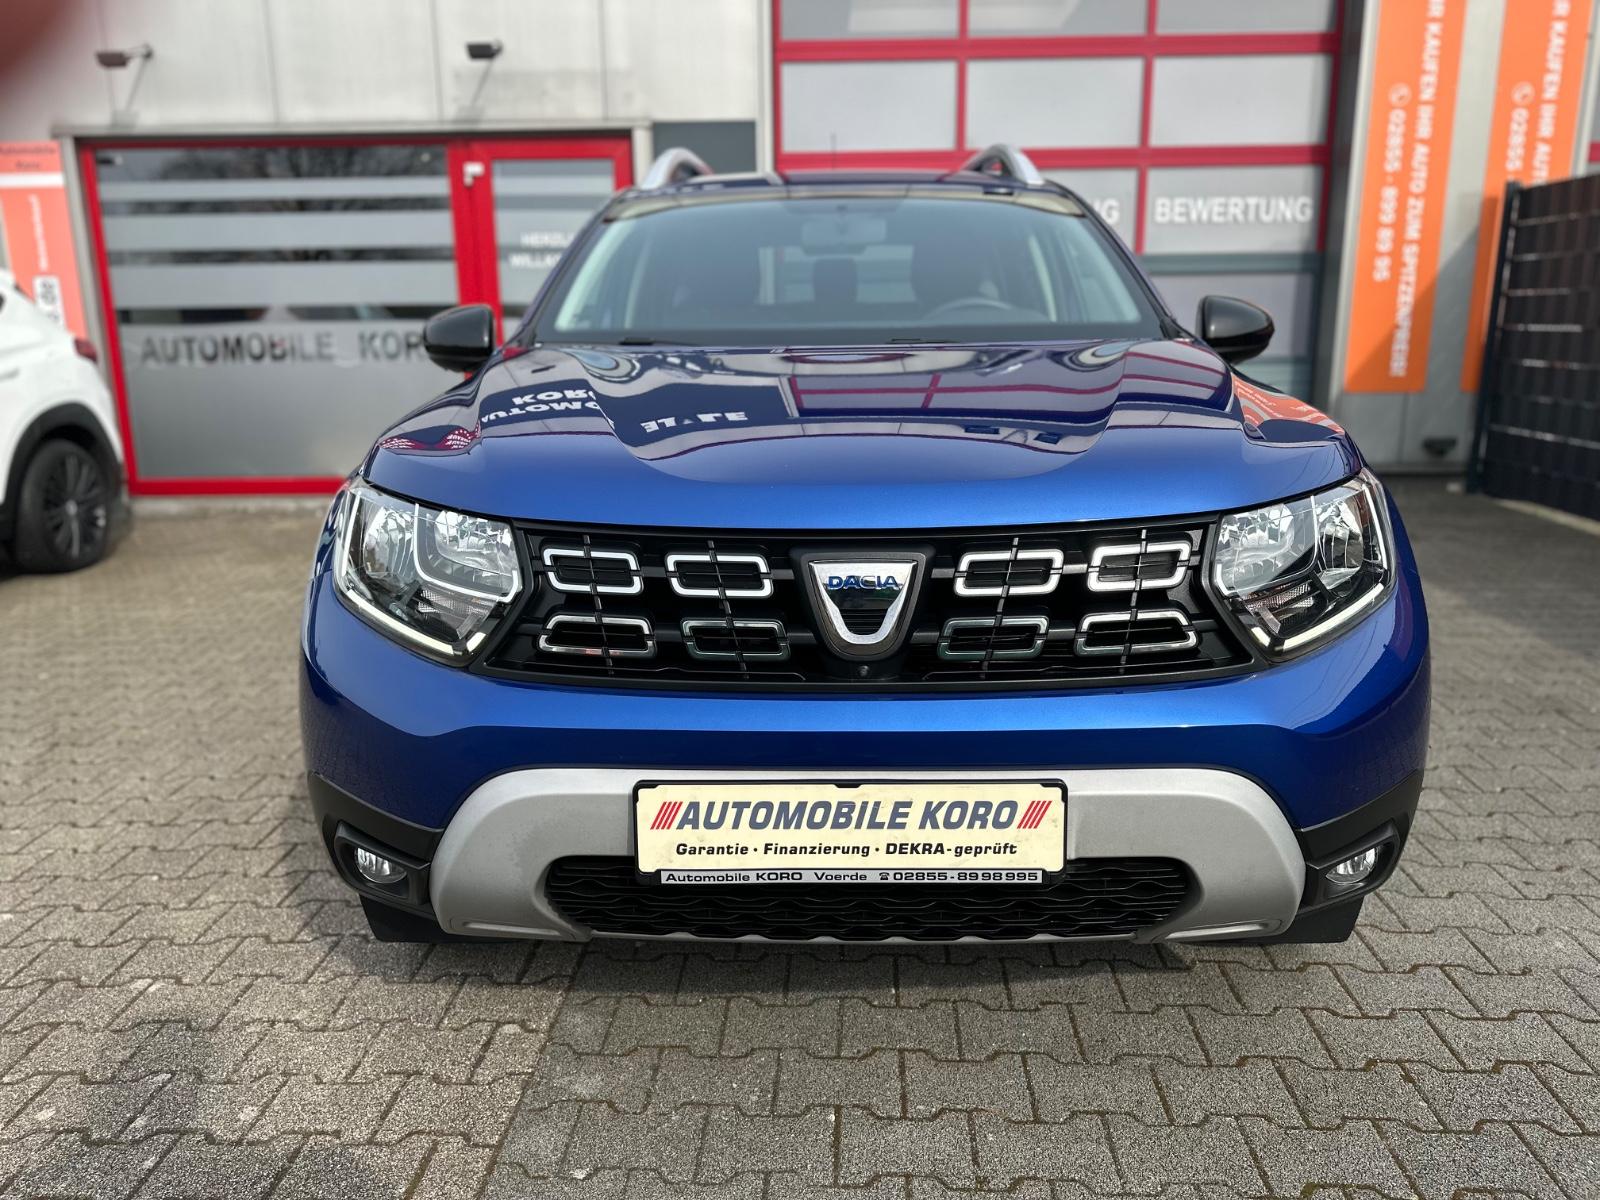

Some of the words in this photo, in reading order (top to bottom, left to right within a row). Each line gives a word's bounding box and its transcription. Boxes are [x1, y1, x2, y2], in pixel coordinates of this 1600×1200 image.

[1408, 142, 1431, 194] AUTO
[1154, 197, 1314, 224] BEWERTUNG
[142, 332, 335, 364] AUTOMOBILE
[358, 331, 424, 362] KOR
[827, 575, 900, 590] DACIA
[676, 800, 913, 830] AUTOMOBILE
[918, 800, 1019, 830] KORO
[676, 843, 749, 856] Garantie
[763, 843, 870, 858] Finanzierung
[665, 872, 750, 882] Automobile
[756, 872, 803, 881] KORO
[814, 871, 867, 881] Voerde
